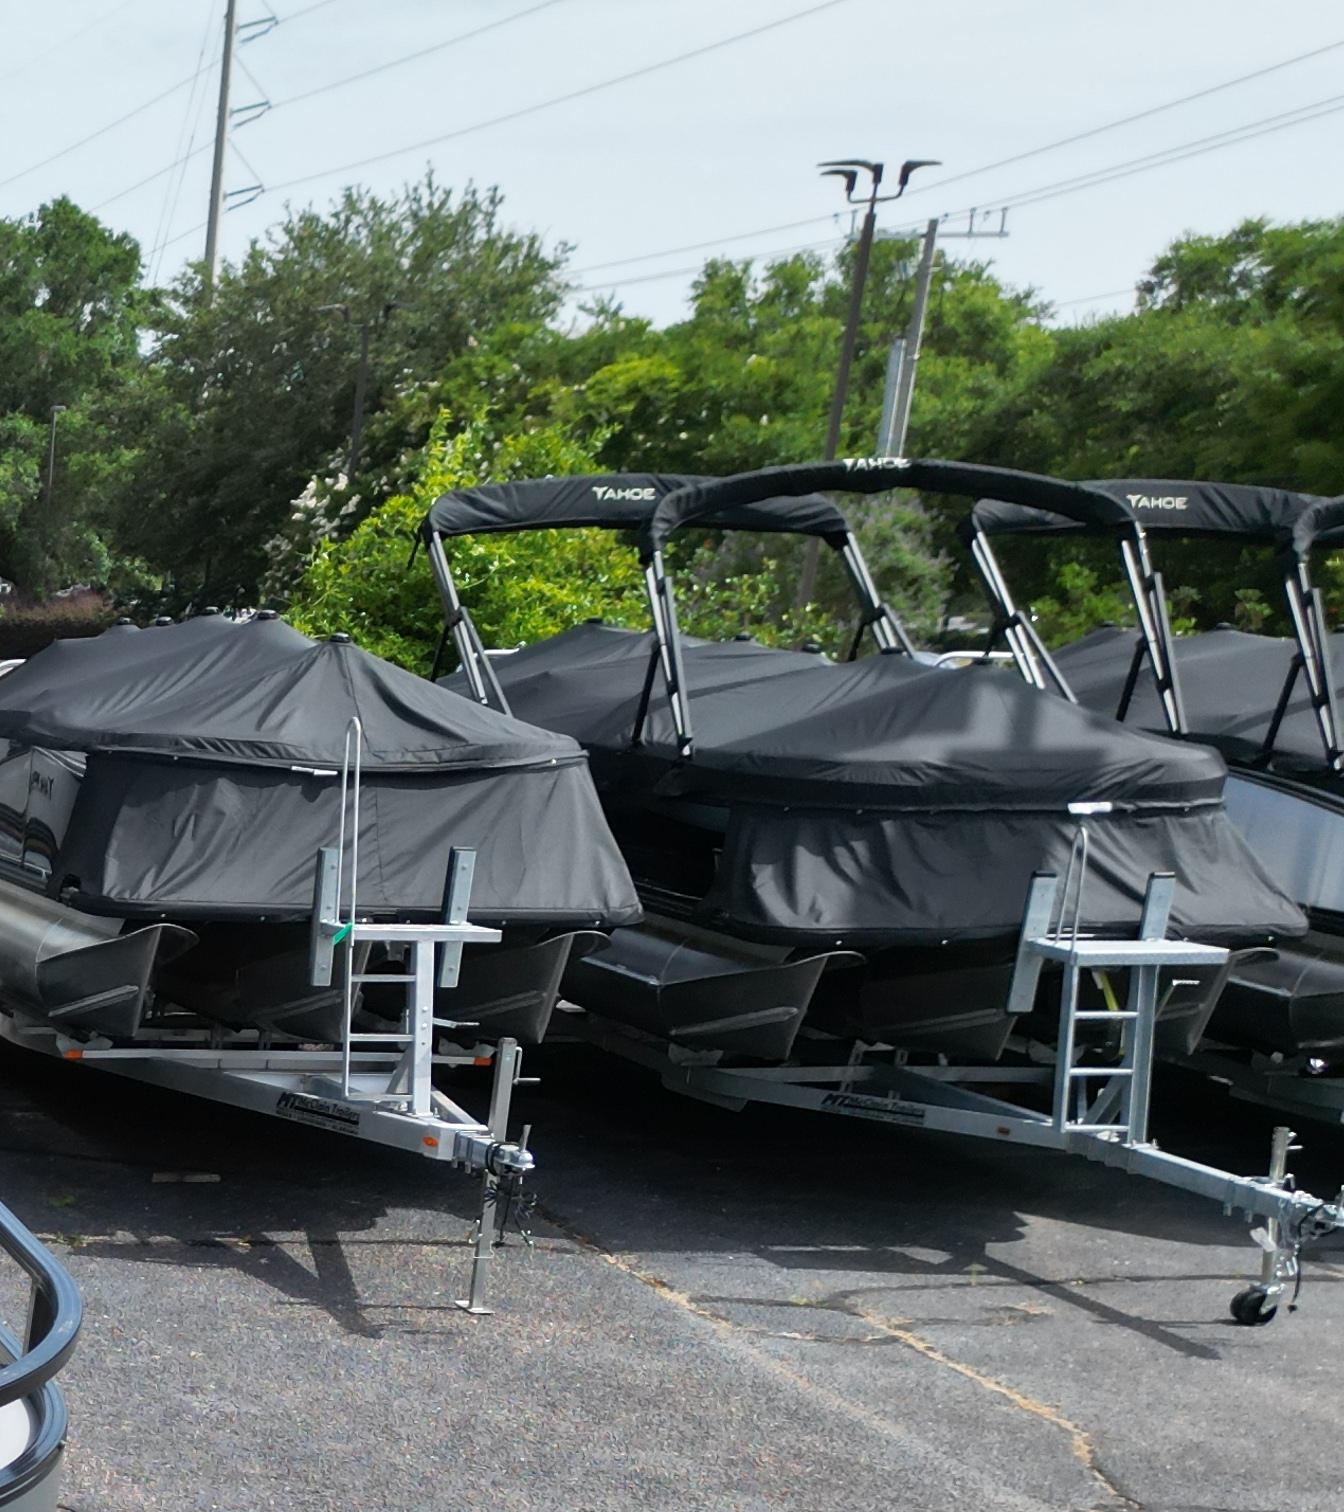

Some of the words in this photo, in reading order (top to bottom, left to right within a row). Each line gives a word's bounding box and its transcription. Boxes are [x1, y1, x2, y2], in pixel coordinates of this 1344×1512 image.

[842, 457, 912, 471] TAHOE
[592, 486, 656, 501] TAHOE
[1126, 494, 1188, 510] TAHOE
